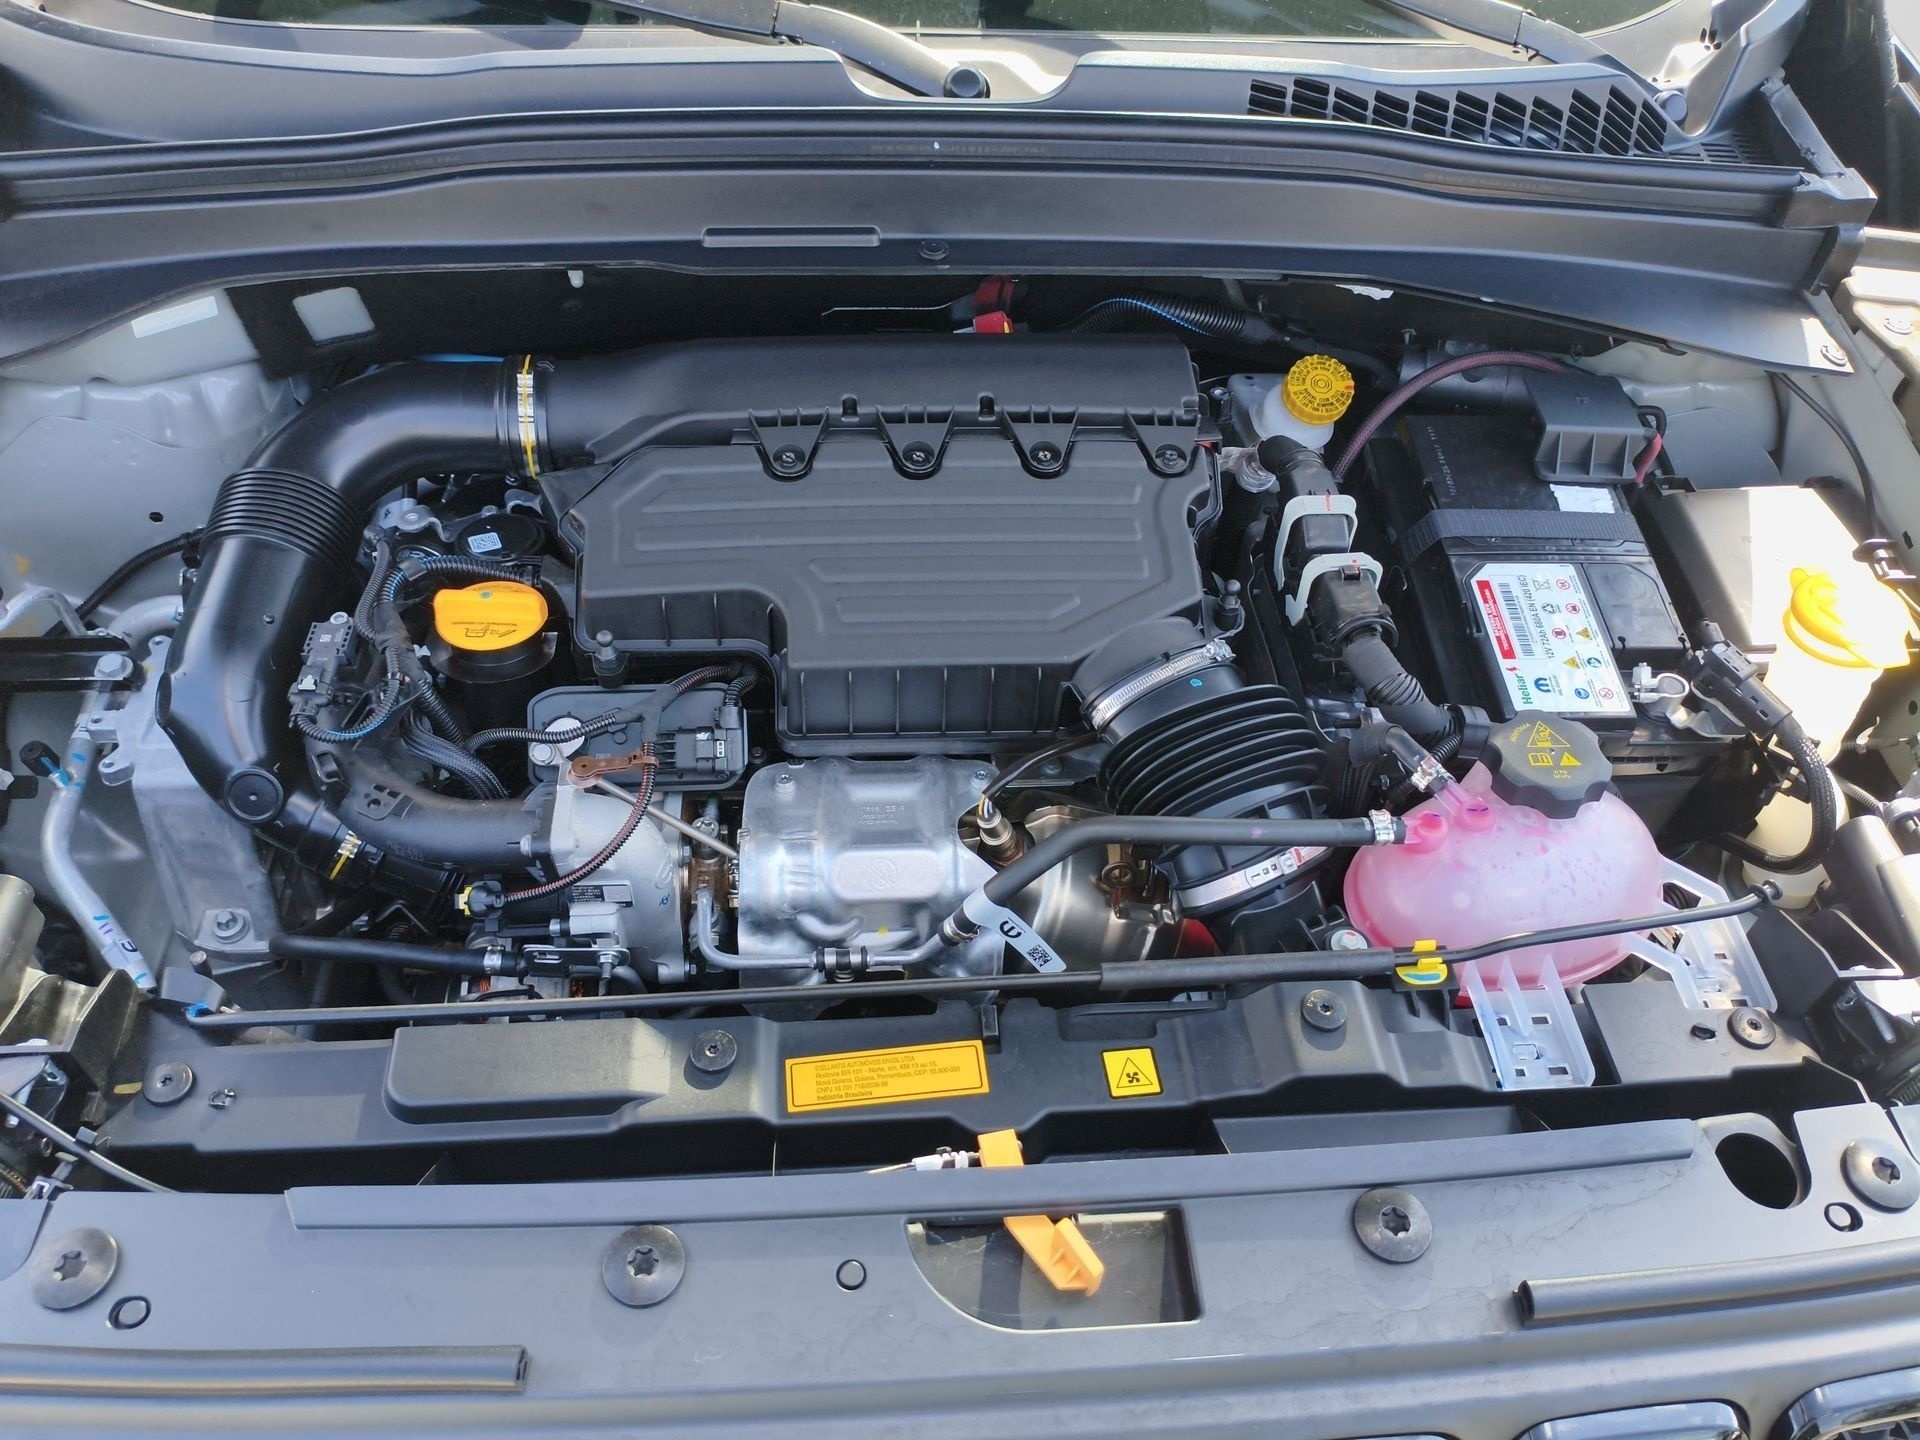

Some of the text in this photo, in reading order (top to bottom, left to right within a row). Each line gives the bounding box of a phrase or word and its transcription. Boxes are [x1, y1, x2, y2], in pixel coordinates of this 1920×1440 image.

[1529, 602, 1537, 612] EN
[1533, 613, 1544, 629] 680A
[1538, 629, 1550, 645] 72Ah
[1544, 647, 1554, 659] 12V
[1516, 675, 1533, 704] Heliar
[815, 1063, 846, 1071] STELLANTIS
[847, 1059, 881, 1068] AUTOMÓVEIS
[817, 1093, 843, 1101] Indústria
